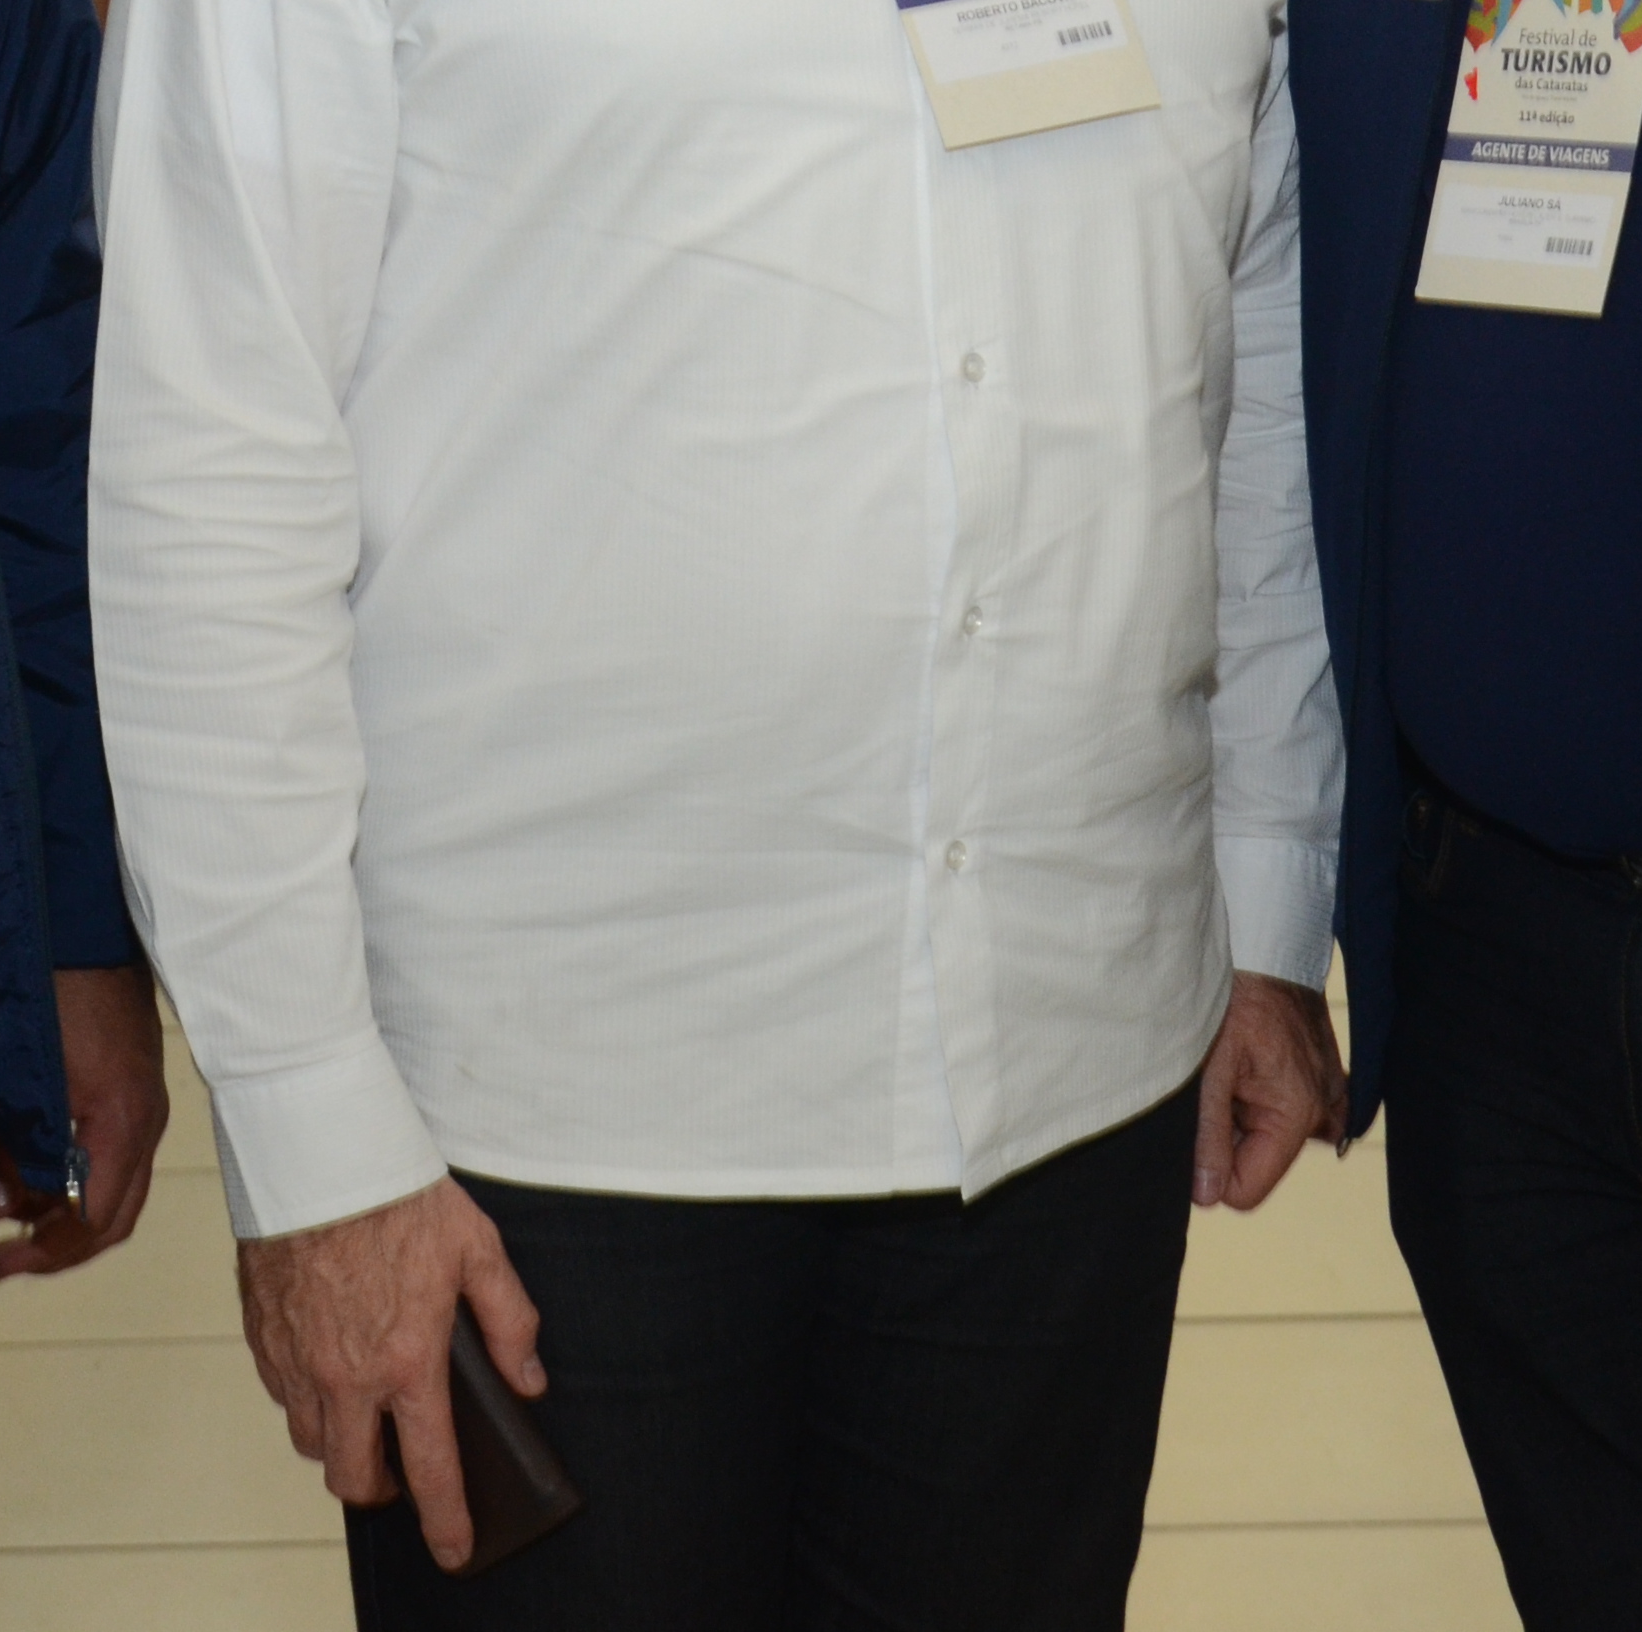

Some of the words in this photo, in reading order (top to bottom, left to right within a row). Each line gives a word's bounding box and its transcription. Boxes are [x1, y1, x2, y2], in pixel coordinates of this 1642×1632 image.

[957, 1, 1018, 22] ROBERTO
[1519, 27, 1575, 46] Festival
[1578, 29, 1597, 47] de
[1501, 48, 1612, 75] TURISMO
[1515, 76, 1533, 89] das
[1536, 78, 1588, 92] Cataratas
[1539, 110, 1575, 126] edição
[1472, 141, 1527, 159] AGENTE
[1528, 144, 1546, 160] DE
[1550, 146, 1610, 165] VIAGENS
[1498, 195, 1544, 209] JULIANO
